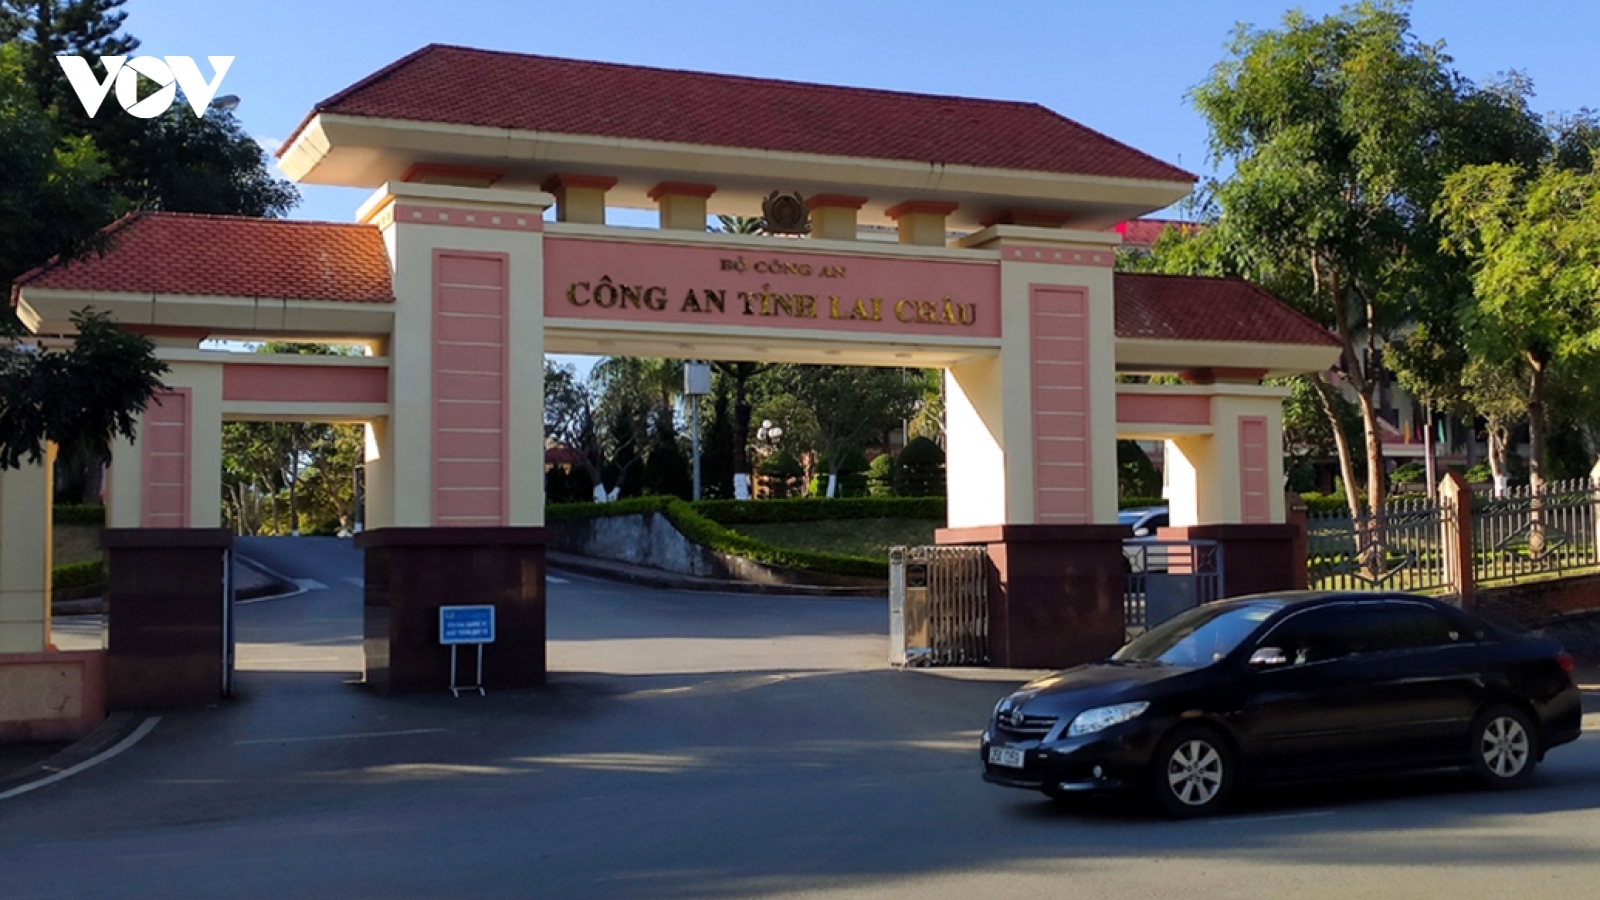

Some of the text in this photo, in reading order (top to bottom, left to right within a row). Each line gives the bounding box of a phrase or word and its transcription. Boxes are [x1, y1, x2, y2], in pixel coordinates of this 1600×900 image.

[720, 255, 846, 278] BỘ CÔNG AN
[567, 275, 668, 312] CÔNG
[680, 288, 726, 315] AN
[829, 295, 883, 322] LAI
[894, 295, 977, 326] CHÂU
